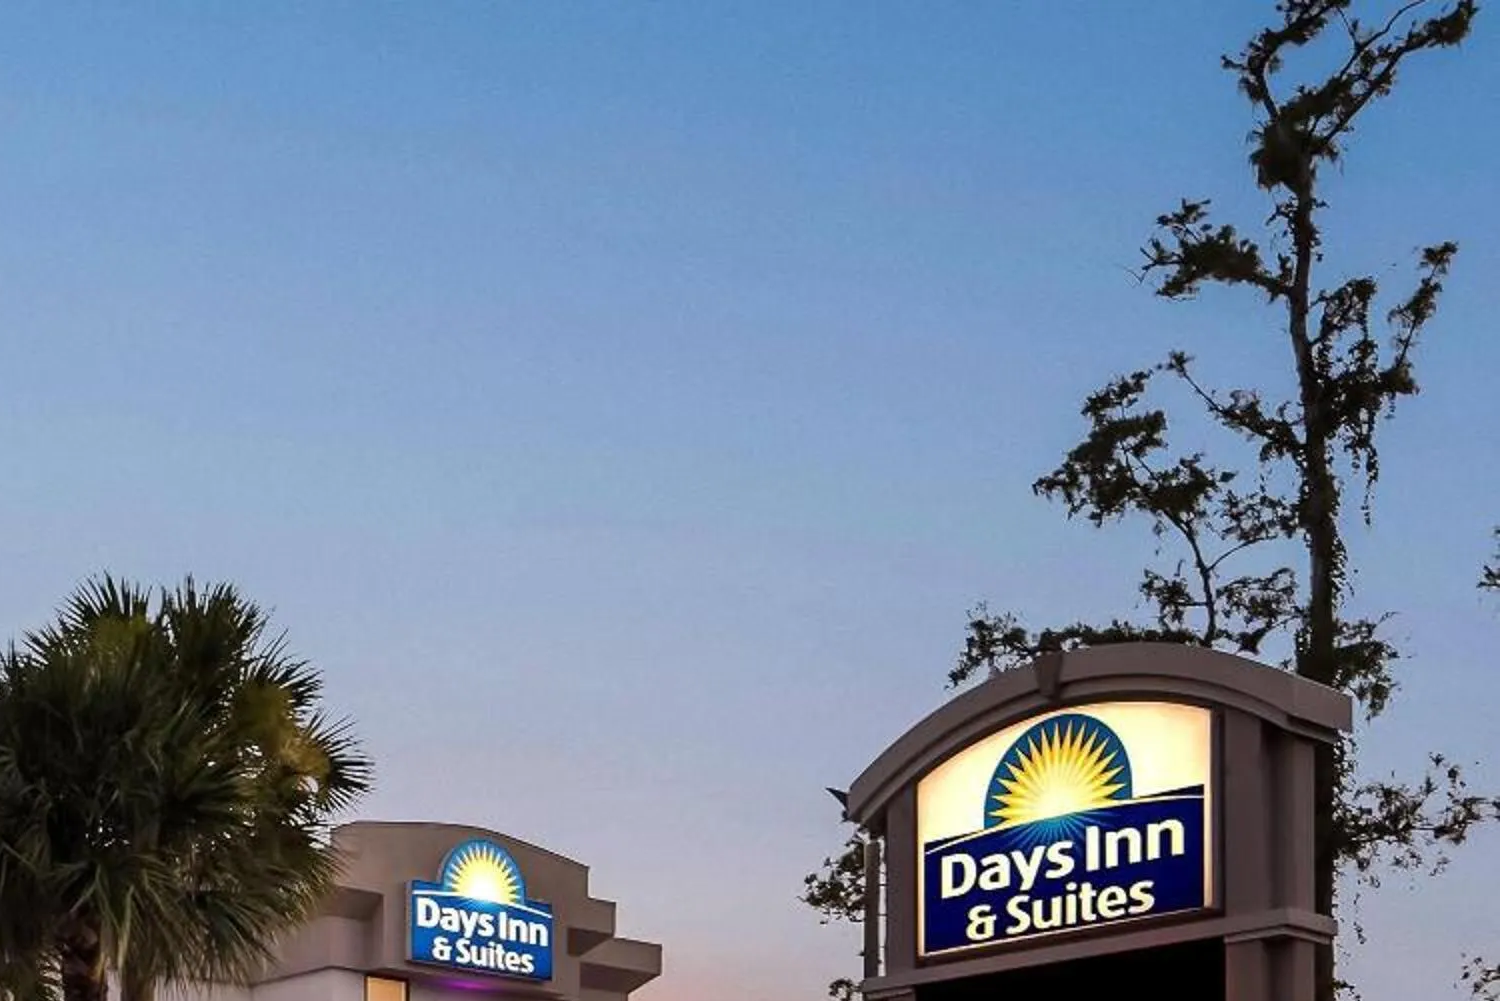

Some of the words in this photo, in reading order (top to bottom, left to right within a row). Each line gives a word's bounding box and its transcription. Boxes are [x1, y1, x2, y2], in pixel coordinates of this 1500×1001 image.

[941, 841, 1075, 899] Days
[1086, 819, 1184, 872] Inn
[417, 897, 494, 938] Days
[498, 912, 548, 946] Inn
[966, 905, 997, 941] &
[1006, 881, 1154, 935] Suites
[432, 937, 452, 961] &
[455, 938, 534, 973] Suites
